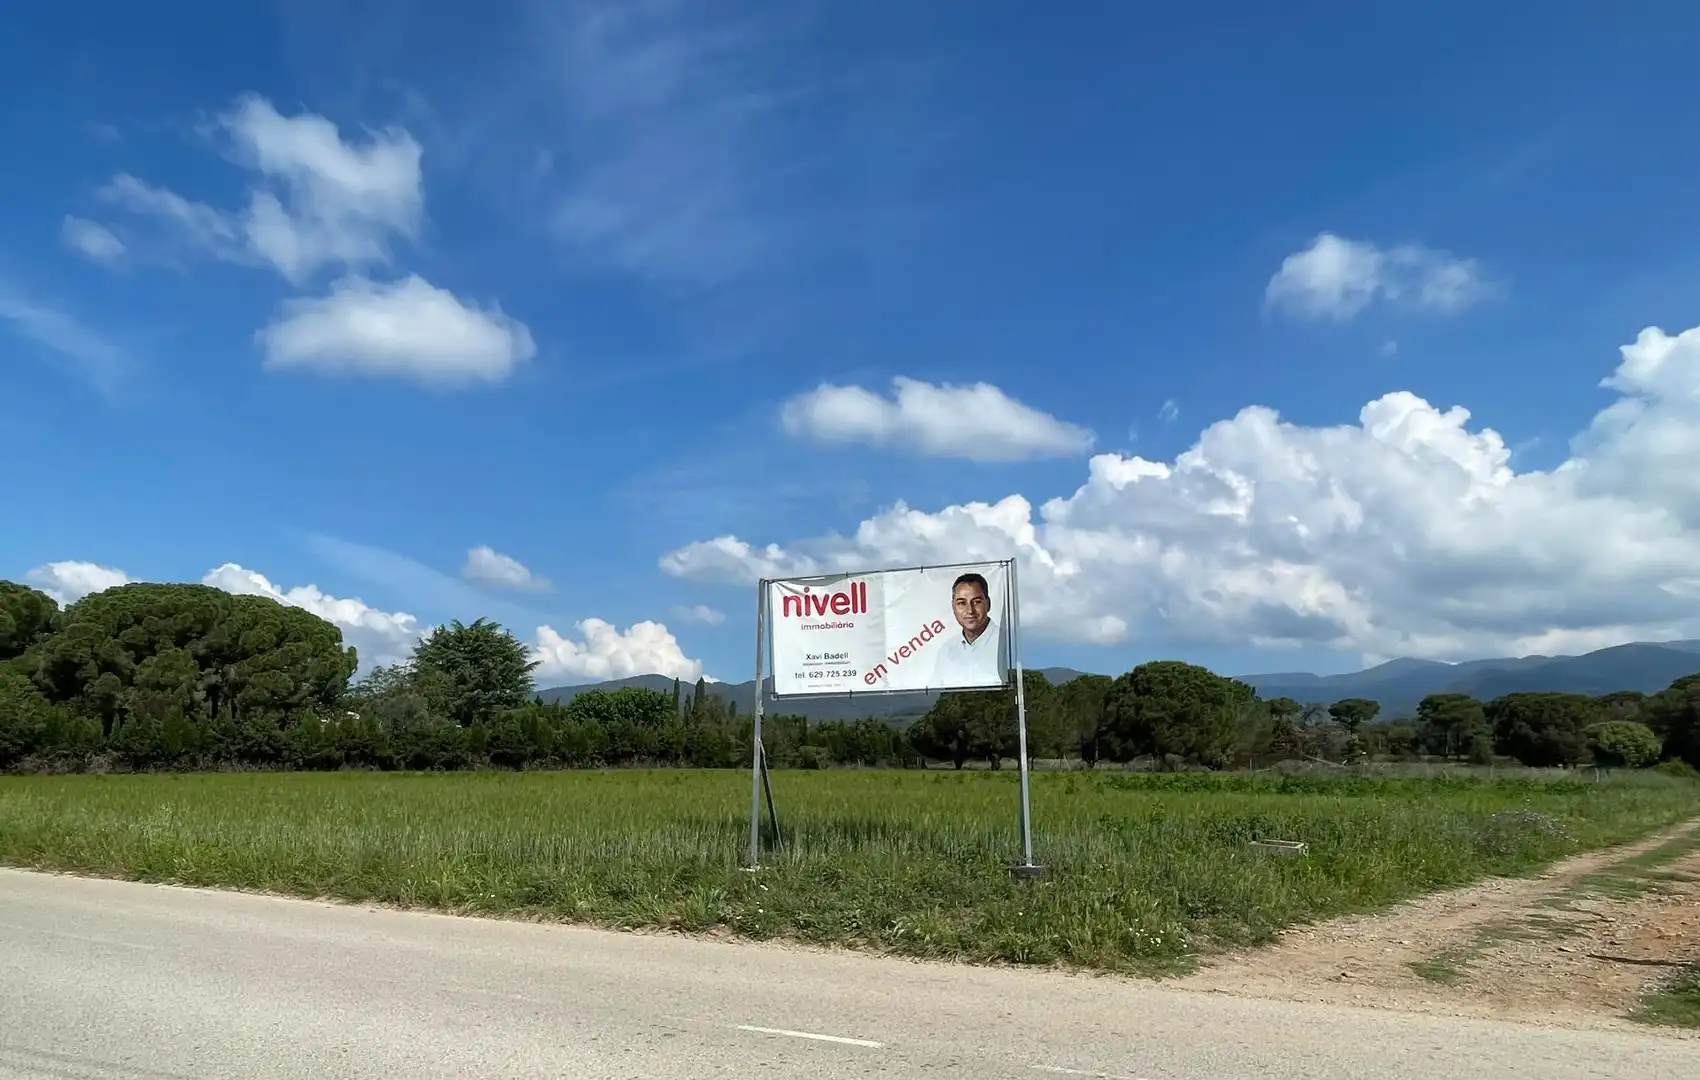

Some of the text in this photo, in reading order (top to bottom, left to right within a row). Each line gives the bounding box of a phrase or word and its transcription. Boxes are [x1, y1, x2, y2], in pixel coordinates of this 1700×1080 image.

[783, 582, 866, 617] nivell
[824, 652, 848, 660] Badell
[864, 619, 946, 686] en venda
